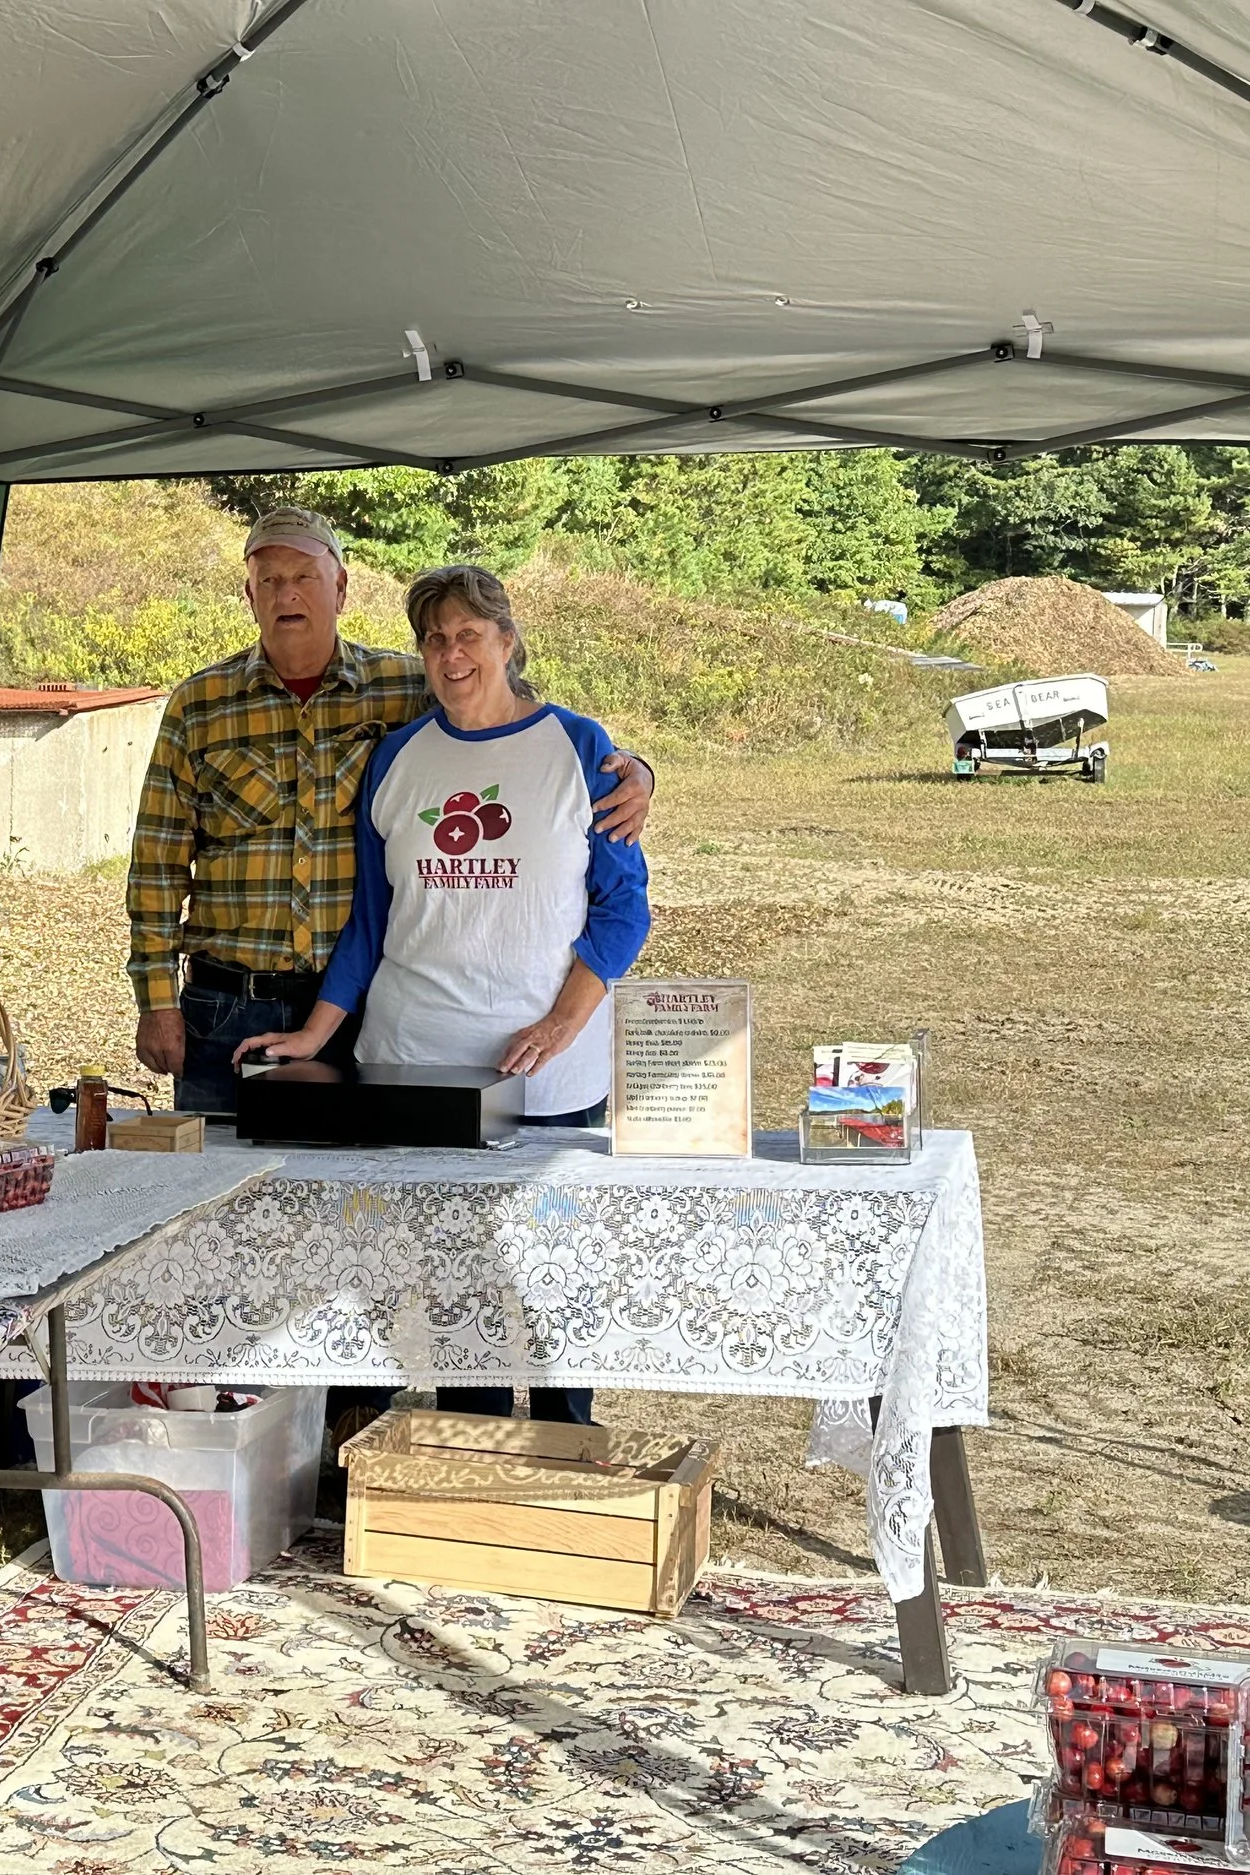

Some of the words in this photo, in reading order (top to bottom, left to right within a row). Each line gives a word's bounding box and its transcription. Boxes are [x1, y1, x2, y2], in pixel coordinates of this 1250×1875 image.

[986, 697, 1011, 711] SEA
[1030, 689, 1061, 704] BEAR
[415, 858, 521, 875] HARTLEY
[423, 876, 473, 889] FAMILY
[474, 876, 515, 889] FARM
